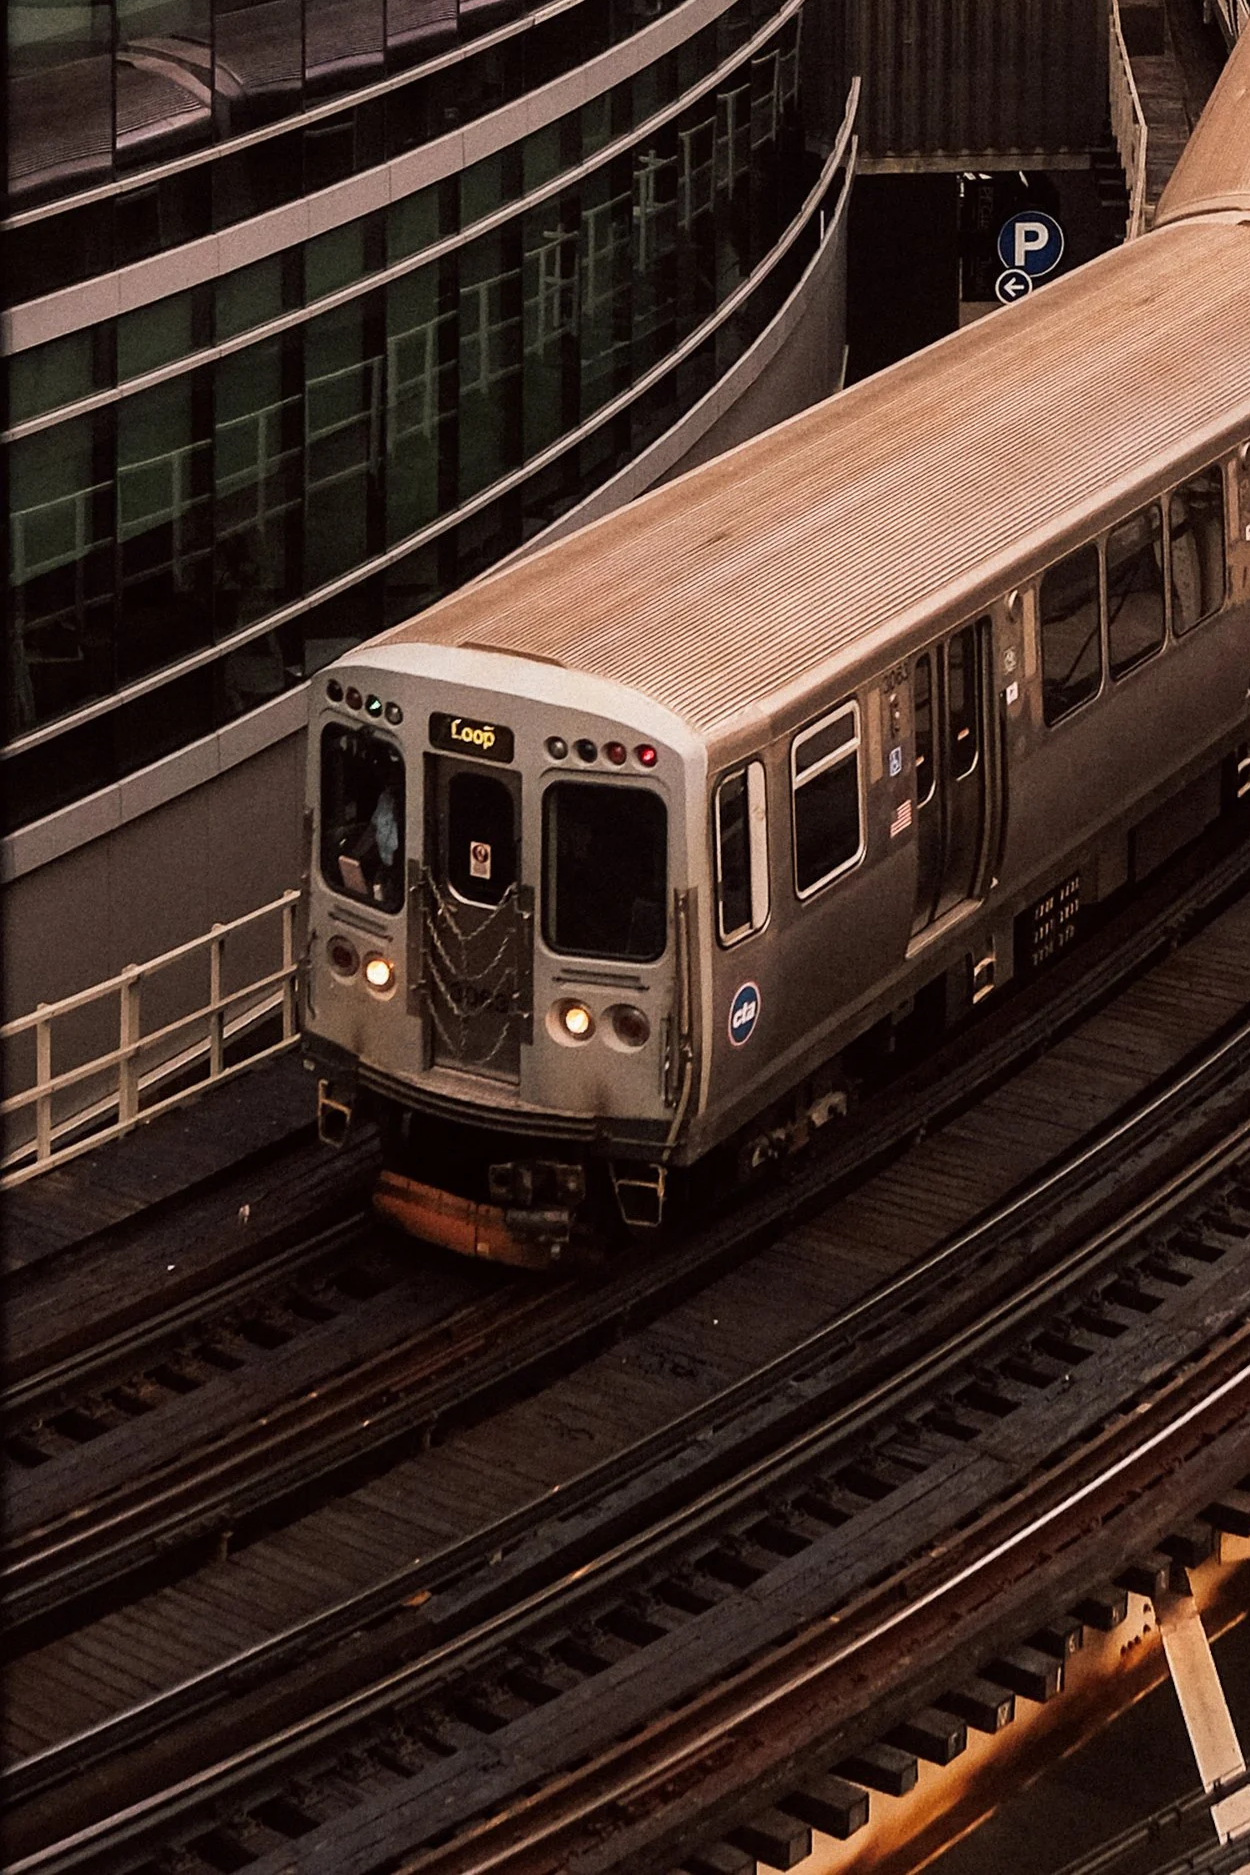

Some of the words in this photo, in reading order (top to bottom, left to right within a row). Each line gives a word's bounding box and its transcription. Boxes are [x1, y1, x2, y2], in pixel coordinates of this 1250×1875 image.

[1014, 221, 1049, 267] P
[451, 718, 496, 750] Loop
[732, 1000, 757, 1029] cta
